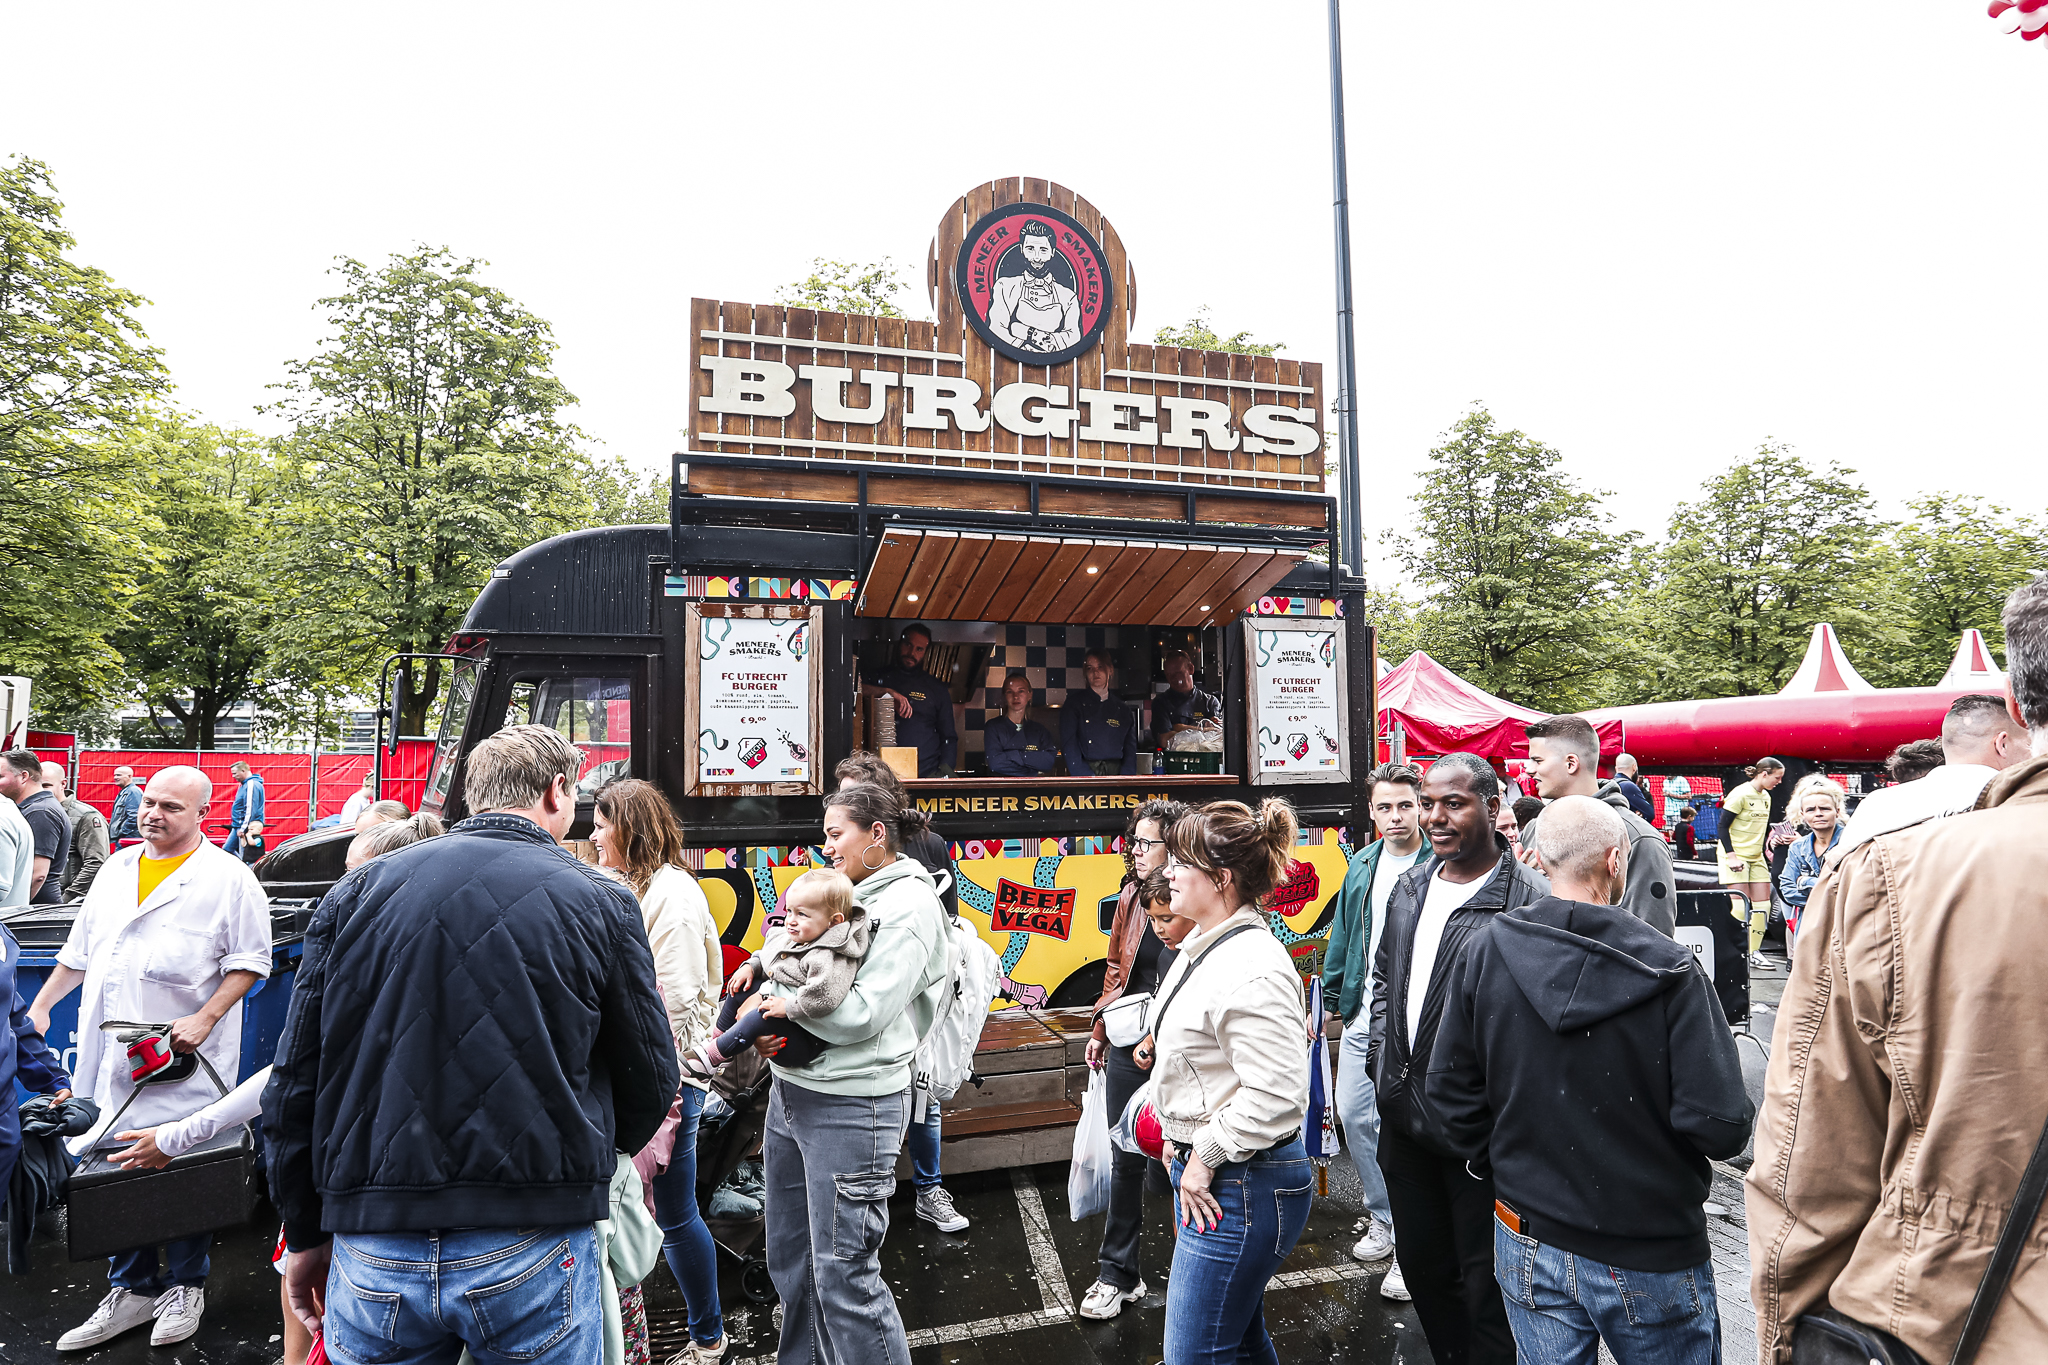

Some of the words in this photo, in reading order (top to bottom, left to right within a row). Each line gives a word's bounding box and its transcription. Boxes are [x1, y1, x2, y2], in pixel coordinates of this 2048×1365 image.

[973, 225, 1010, 293] MENEER
[1060, 231, 1100, 317] SMAKERS
[697, 354, 1323, 456] BURGERS
[735, 641, 776, 649] MENEER
[729, 648, 782, 657] SMAKERS
[1277, 656, 1316, 664] SMAKERS
[721, 673, 735, 681] FC
[737, 673, 788, 681] UTRECHT
[732, 683, 778, 691] BURGER
[1280, 686, 1315, 694] BURGER
[741, 739, 765, 763] UTRECHT
[753, 753, 762, 763] C
[916, 797, 1019, 814] MENEER
[1023, 793, 1140, 812] SMAKERS
[999, 882, 1072, 911] BEEF
[1042, 904, 1060, 915] uit
[998, 909, 1066, 937] VEGA
